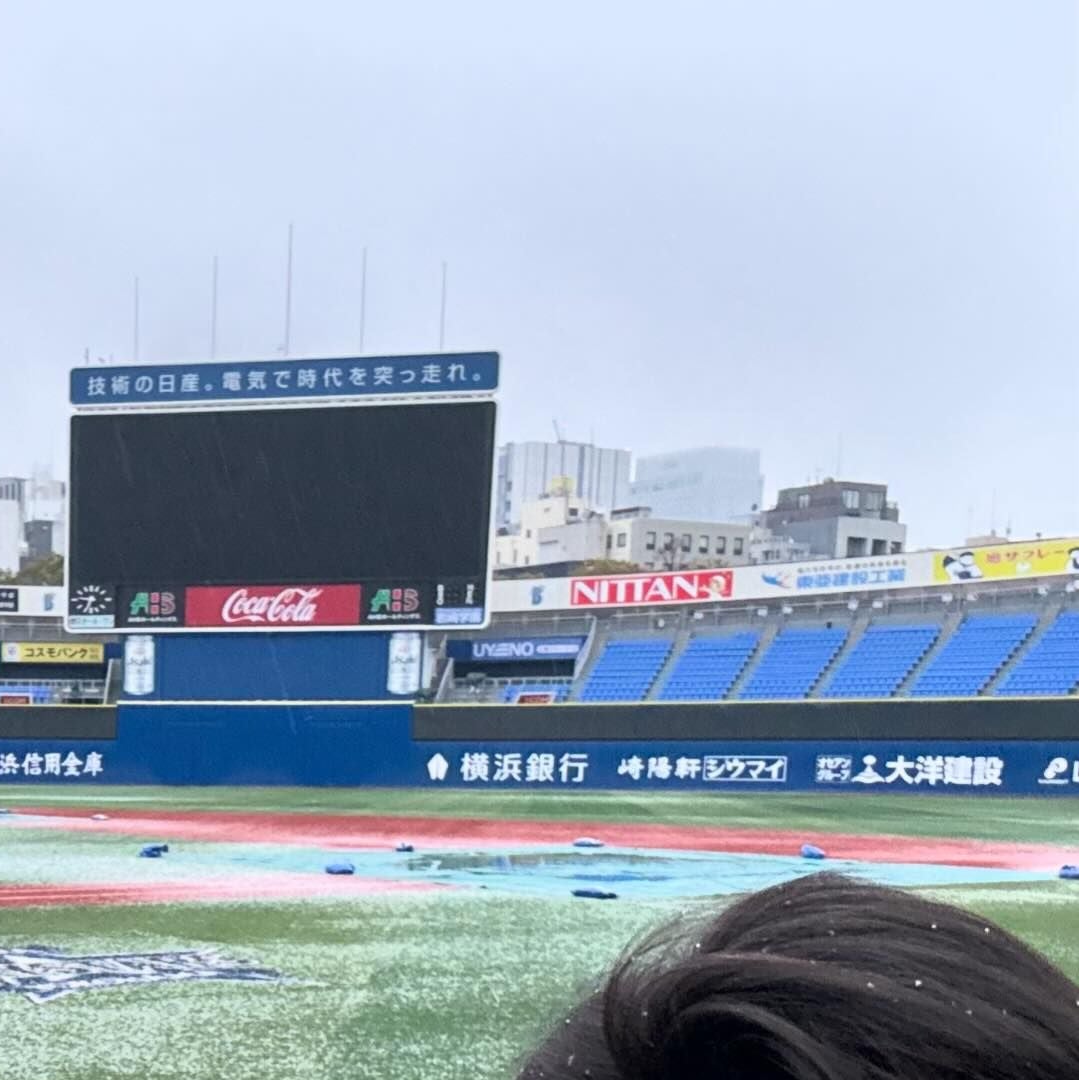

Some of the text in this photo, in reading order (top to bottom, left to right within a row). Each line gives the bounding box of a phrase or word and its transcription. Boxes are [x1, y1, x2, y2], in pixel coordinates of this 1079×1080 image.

[87, 363, 481, 396] 技術の日産。電気で時代を突っ走れ。
[573, 575, 699, 604] NITTAN
[24, 647, 88, 658] コスモバンク
[473, 641, 535, 657] UYENO
[460, 752, 589, 783] 横浜銀行
[706, 758, 785, 780] シウマイ
[885, 755, 1004, 786] 大洋建設
